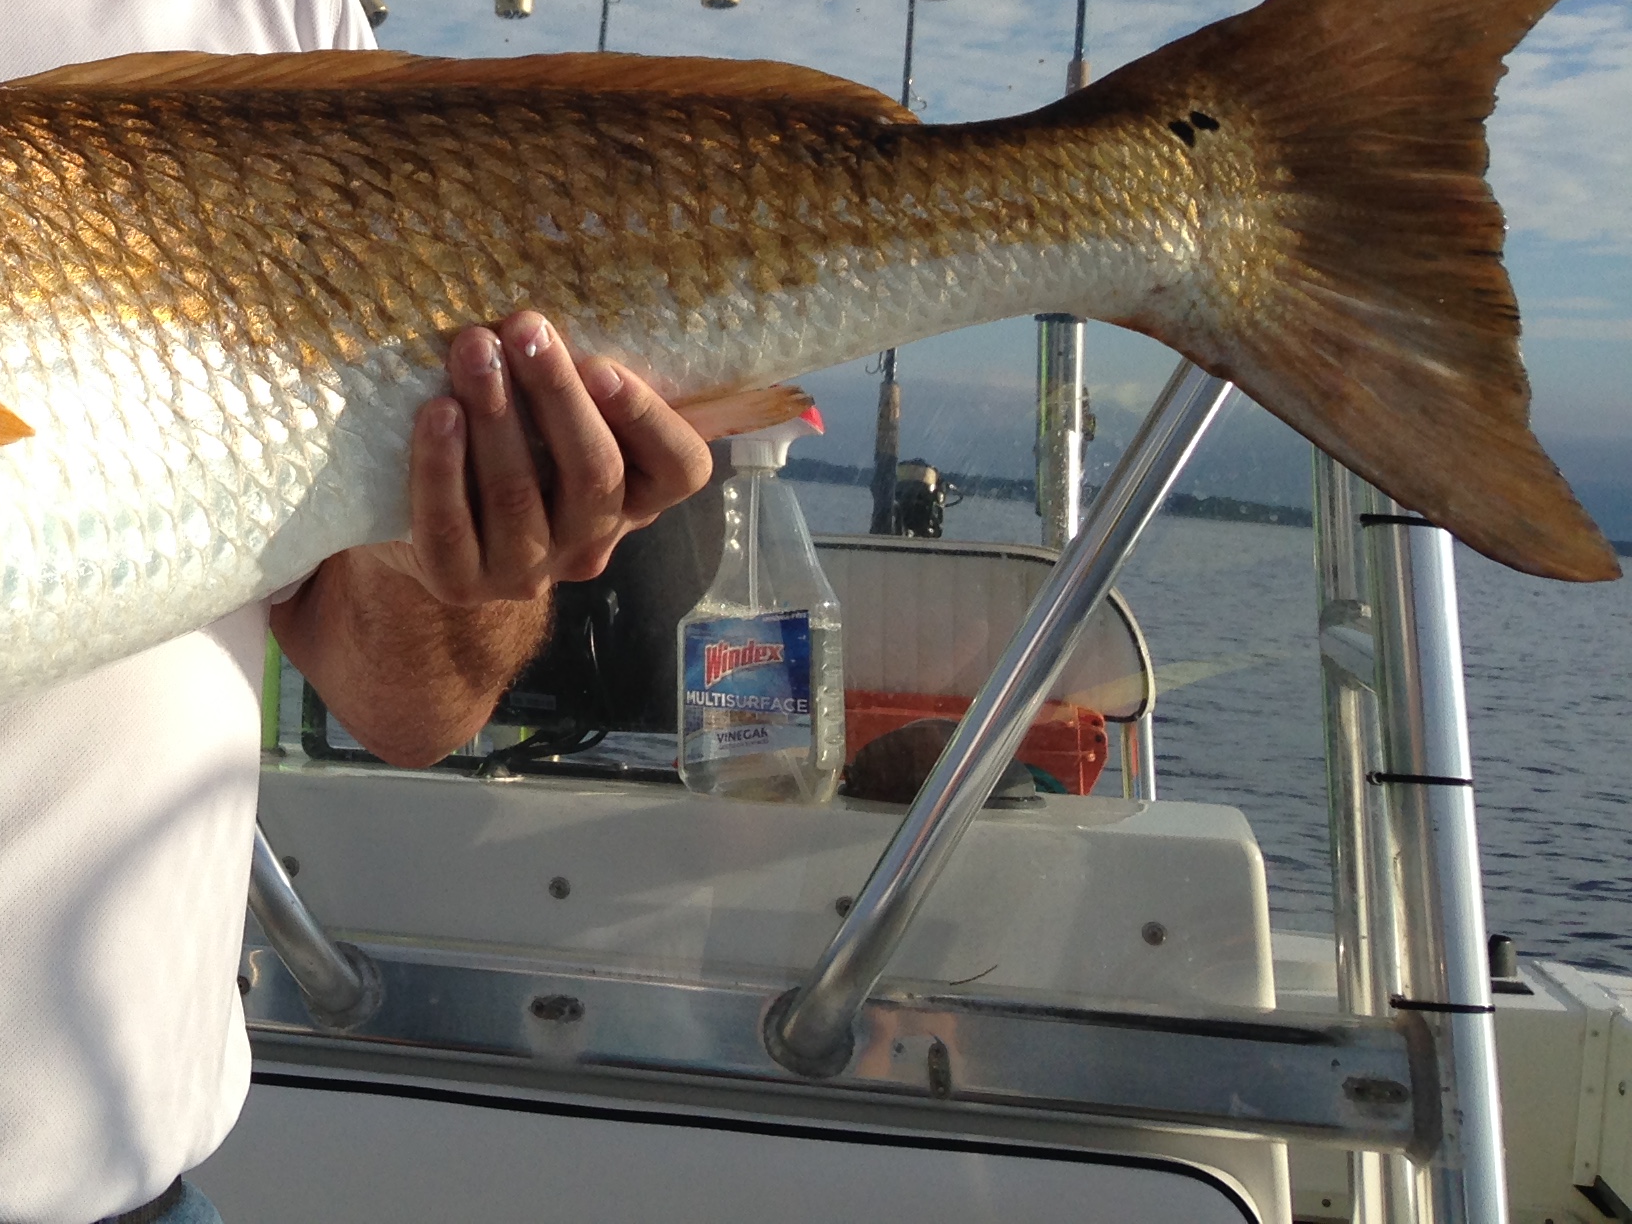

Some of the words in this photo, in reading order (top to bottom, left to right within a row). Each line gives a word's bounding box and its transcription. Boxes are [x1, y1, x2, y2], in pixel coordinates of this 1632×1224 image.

[704, 638, 784, 690] Windex
[686, 690, 808, 713] MULTISURFACE
[716, 727, 769, 743] VINEGAR
